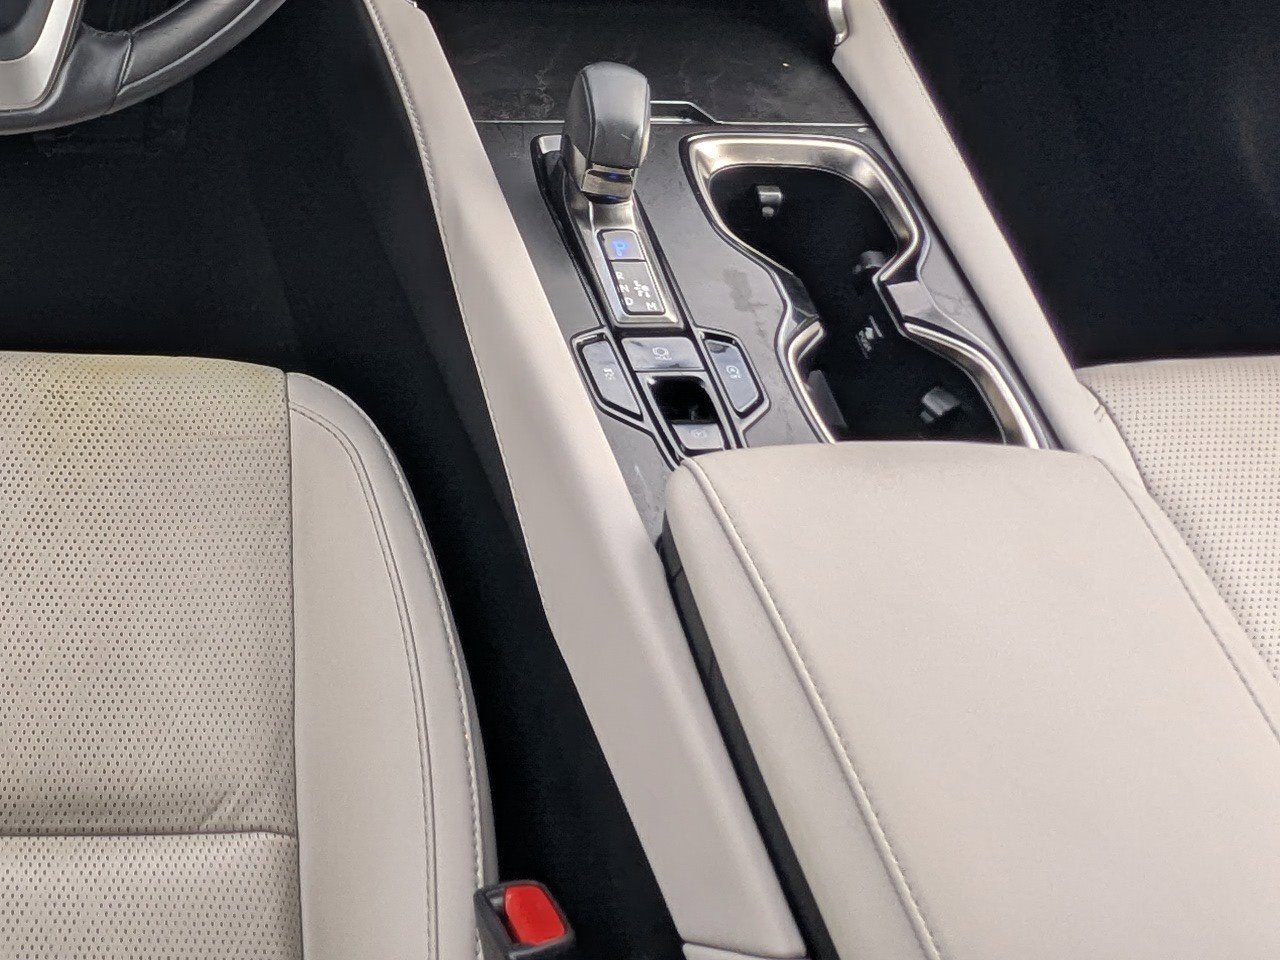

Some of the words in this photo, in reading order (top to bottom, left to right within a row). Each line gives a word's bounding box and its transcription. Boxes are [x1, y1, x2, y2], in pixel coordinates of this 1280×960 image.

[612, 240, 628, 256] P
[616, 271, 625, 280] R
[625, 297, 634, 305] D
[646, 301, 657, 311] M
